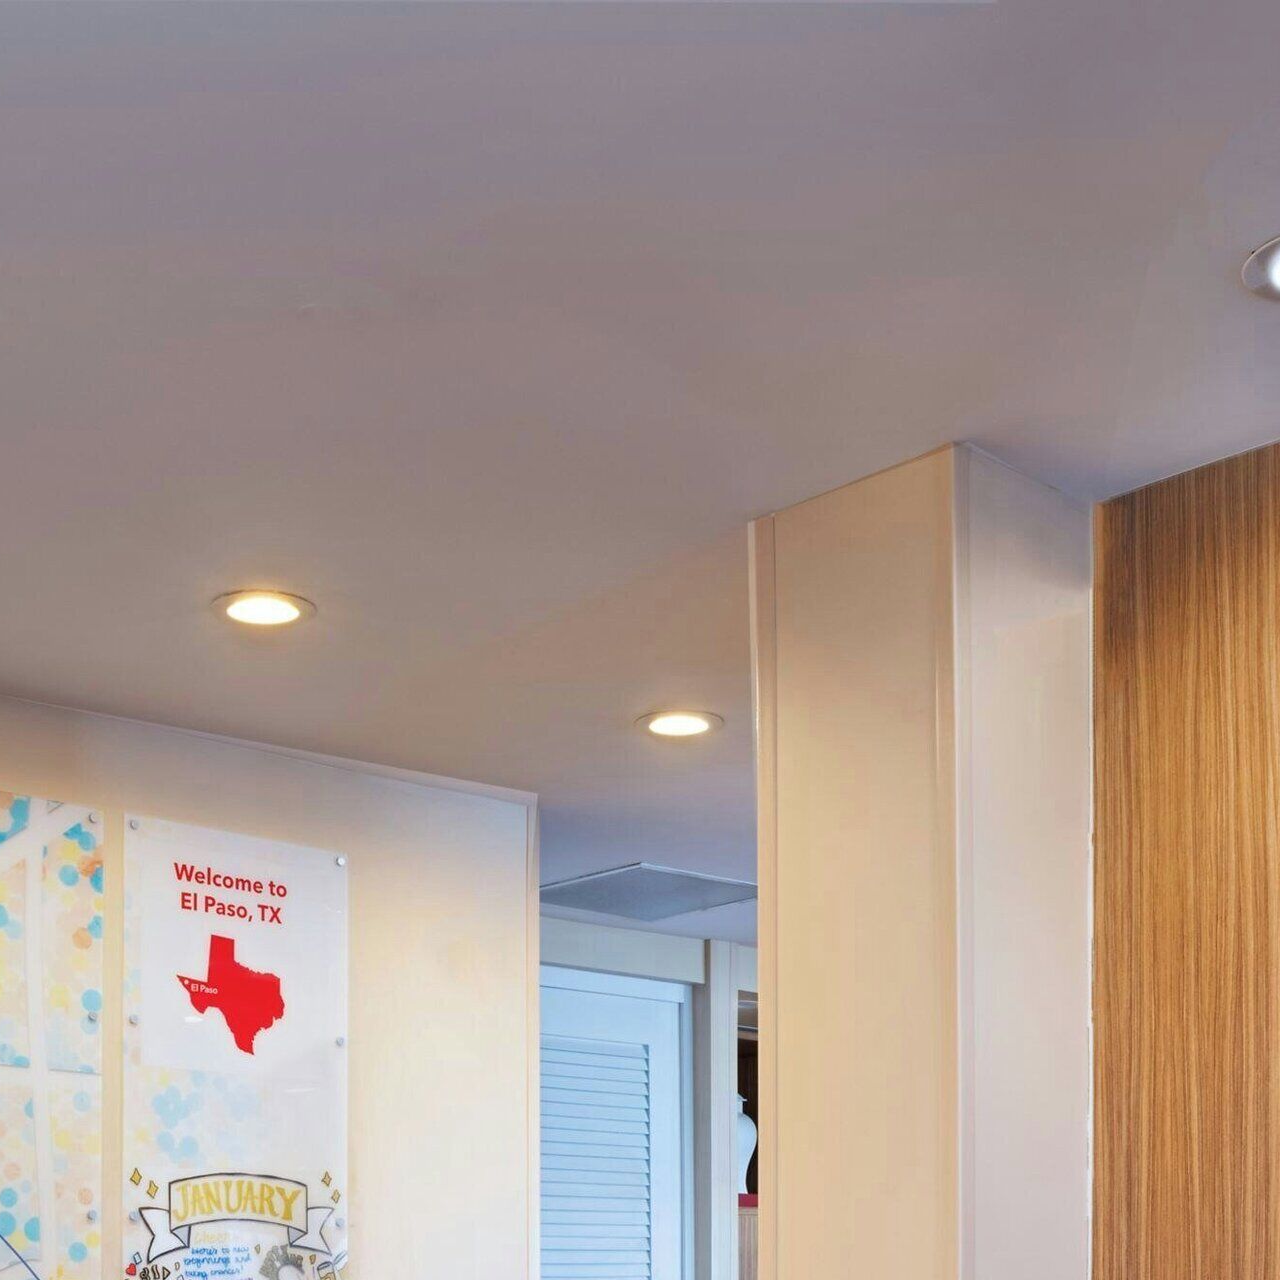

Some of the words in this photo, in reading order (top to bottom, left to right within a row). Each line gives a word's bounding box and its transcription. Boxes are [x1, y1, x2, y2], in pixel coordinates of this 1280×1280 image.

[173, 861, 264, 894] Welcome
[268, 877, 288, 898] to
[180, 892, 198, 911] El
[204, 895, 253, 923] Paso,
[257, 905, 282, 925] TX
[190, 983, 199, 993] El
[200, 984, 219, 995] Paso
[173, 1179, 302, 1222] JANUARY
